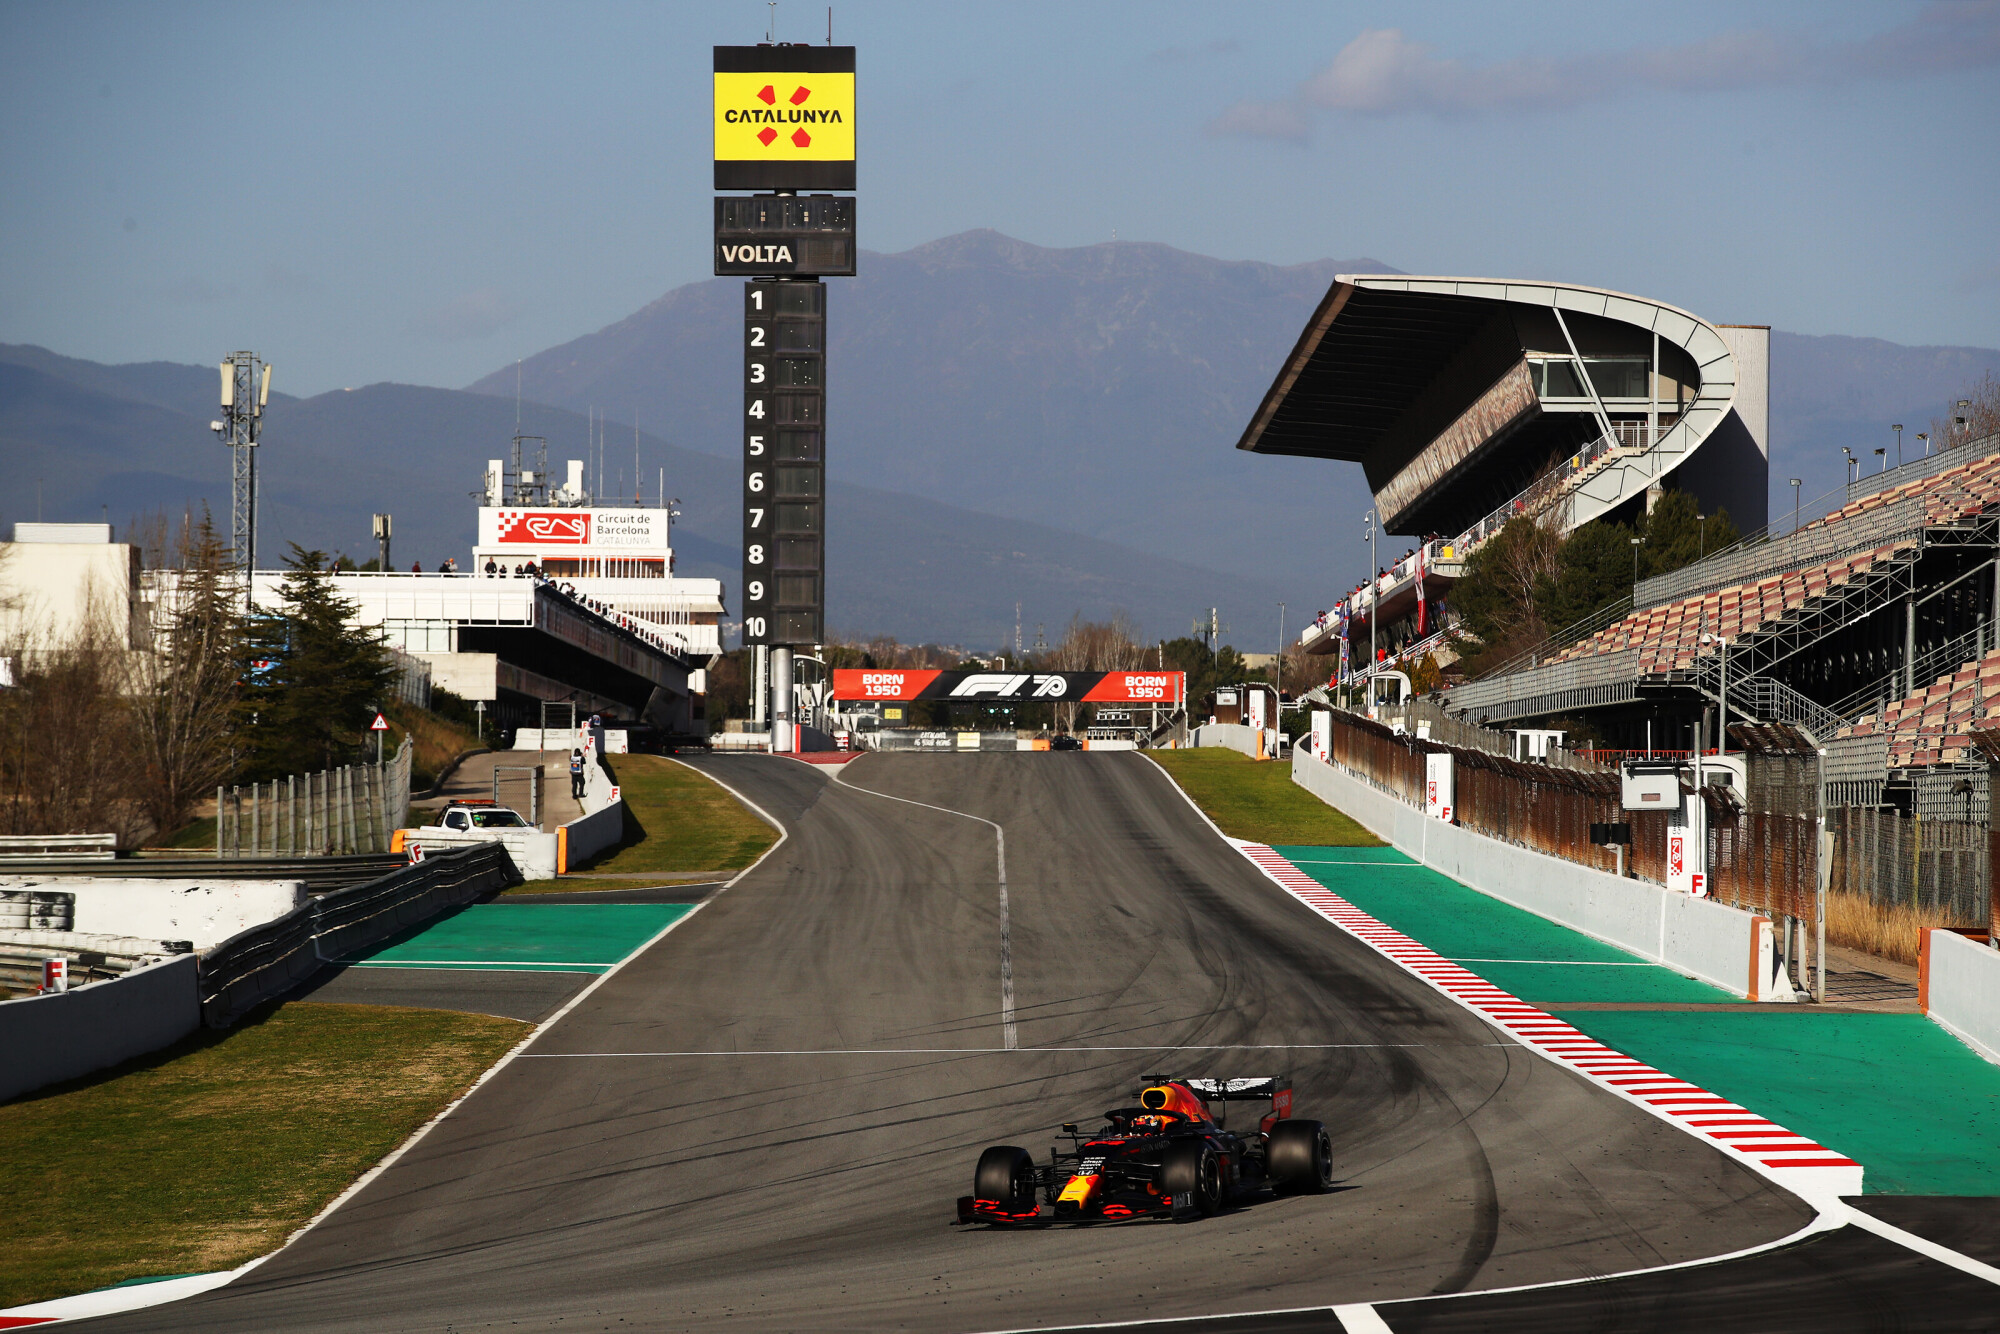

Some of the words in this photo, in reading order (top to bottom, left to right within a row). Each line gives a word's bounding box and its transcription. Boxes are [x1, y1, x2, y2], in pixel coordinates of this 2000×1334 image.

[725, 109, 843, 124] CATALUNYA
[721, 245, 793, 263] VOLTA
[751, 291, 763, 310] 1
[751, 327, 766, 347] 2
[750, 364, 766, 383] 3
[749, 400, 765, 419] 4
[750, 436, 764, 456] 5
[749, 472, 764, 492] 6
[598, 514, 634, 523] Circuit
[637, 514, 650, 523] de
[749, 509, 764, 528] 7
[597, 525, 650, 534] Barcelona
[597, 536, 651, 545] CATALUNYA
[749, 545, 764, 565] 8
[749, 581, 764, 601] 9
[746, 617, 766, 637] 10
[862, 674, 904, 685] BORN
[949, 674, 1031, 697] F1
[1125, 676, 1167, 687] BORN
[865, 685, 901, 696] 1950
[1127, 687, 1164, 698] 1950
[1320, 751, 1326, 760] F
[611, 788, 618, 798] F
[1442, 807, 1450, 819] F
[412, 843, 422, 860] F
[1692, 875, 1704, 893] F
[46, 962, 63, 988] F
